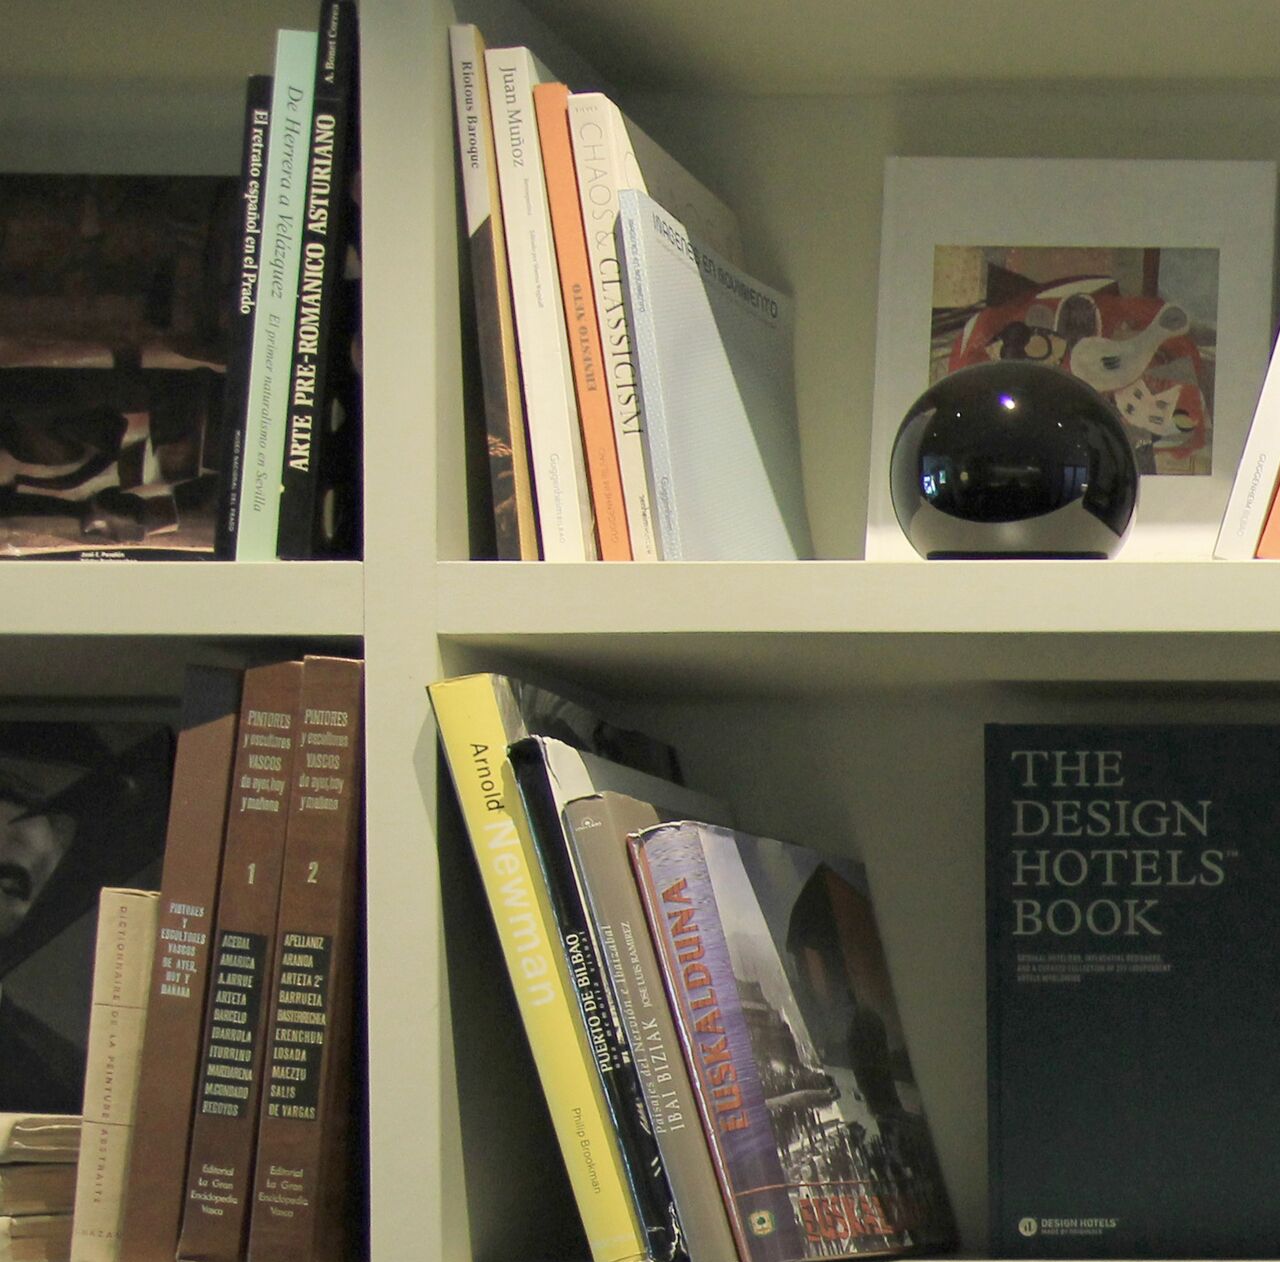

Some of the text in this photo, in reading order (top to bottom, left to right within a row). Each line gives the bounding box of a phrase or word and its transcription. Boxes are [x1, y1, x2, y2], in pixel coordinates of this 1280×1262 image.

[286, 85, 303, 111] De
[461, 61, 480, 169] Riotous Baroque
[498, 66, 523, 166] Juan Muñoz
[278, 118, 301, 189] Herrera
[239, 109, 268, 314] El retrato español en el Prado
[266, 212, 294, 299] Velázquez
[288, 414, 312, 471] ARTE
[308, 113, 335, 234] ASTURIANO
[578, 119, 643, 435] CHAOS & CLASSICISM
[248, 710, 291, 729] PINTORES
[1011, 751, 1125, 787] THE
[1011, 800, 1213, 837] DESIGN
[247, 863, 256, 885] 1
[307, 862, 319, 883] 2
[470, 743, 555, 1008] Arnold Newman
[1012, 899, 1163, 936] BOOK
[565, 933, 612, 1072] PUERTO DE BILBAO
[662, 878, 750, 1133] EUSKALDUNA
[641, 1017, 685, 1131] IBAI BIZIAK
